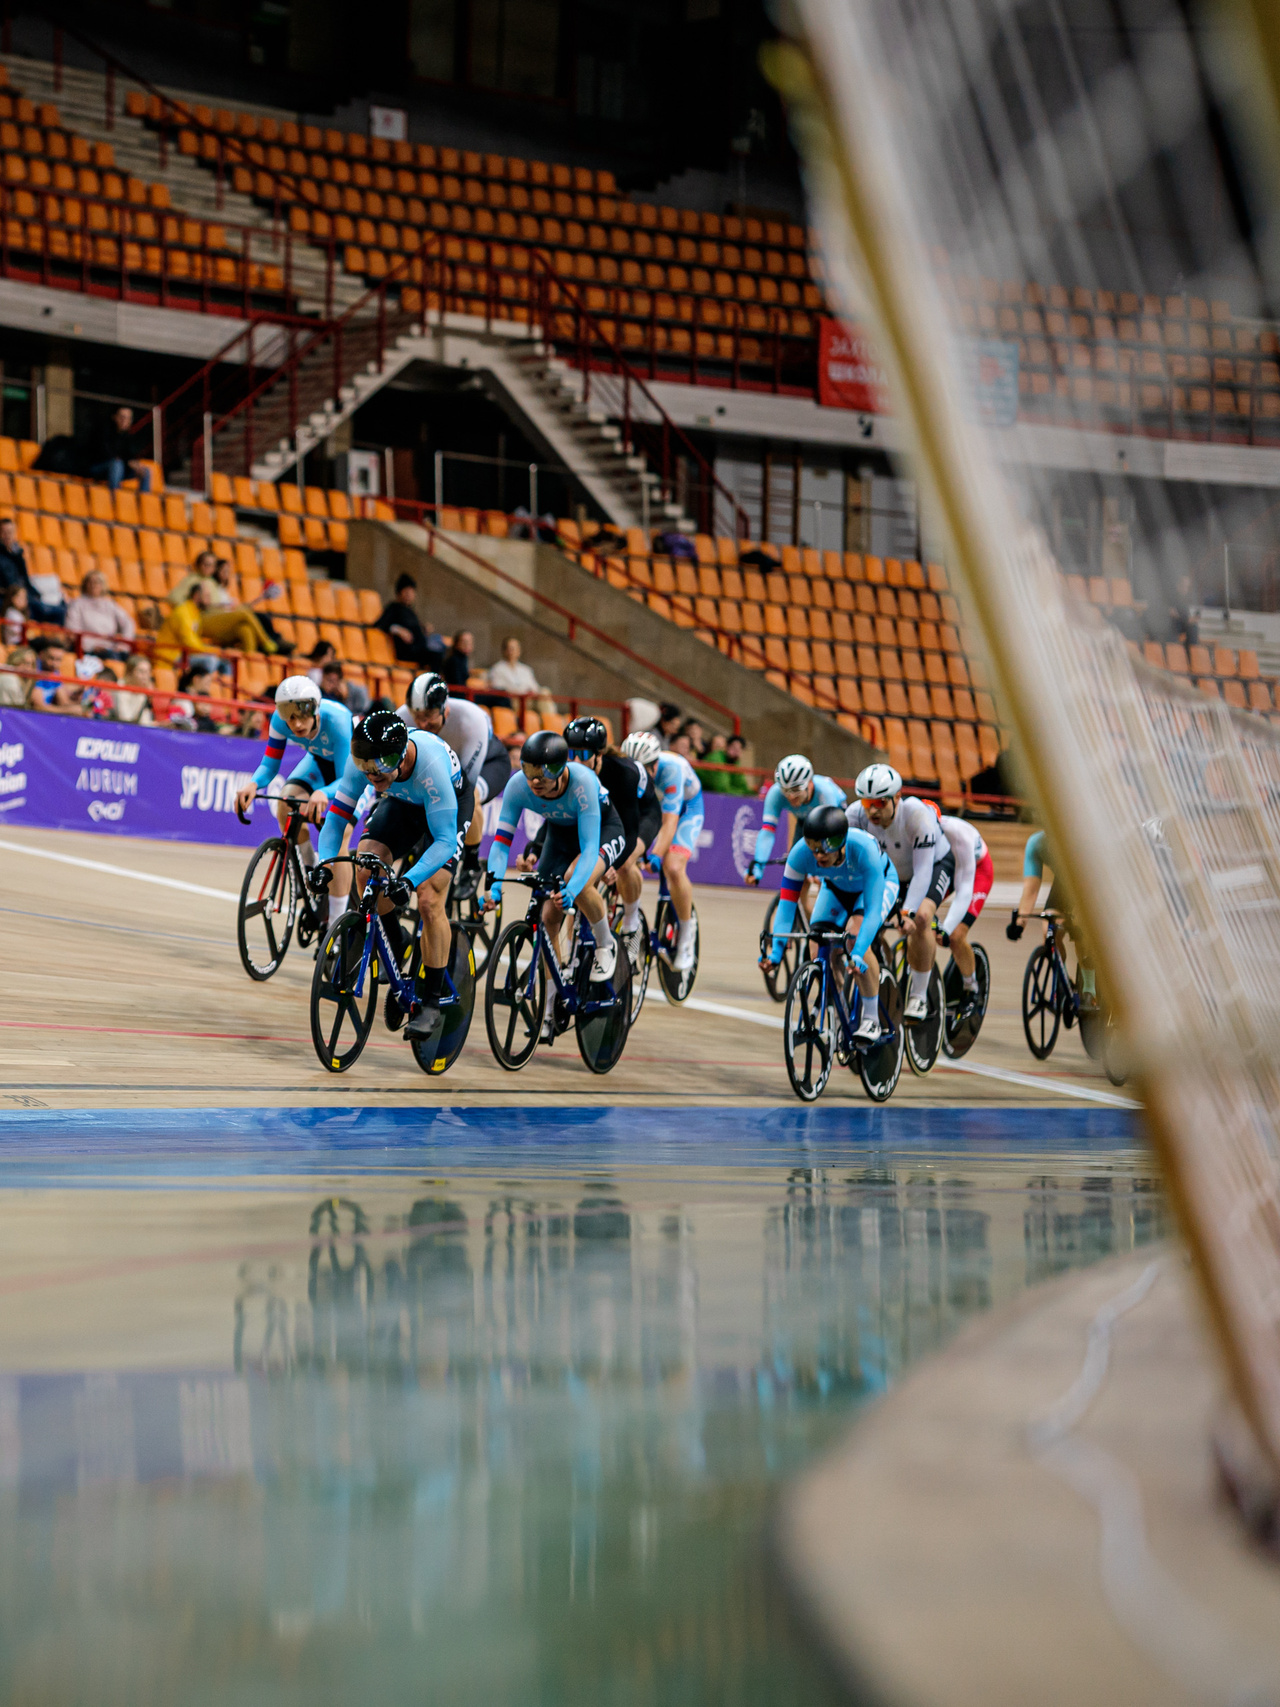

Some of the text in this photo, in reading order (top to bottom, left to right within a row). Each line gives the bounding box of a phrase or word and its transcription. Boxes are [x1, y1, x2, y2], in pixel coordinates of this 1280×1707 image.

[76, 768, 138, 796] AURUM
[180, 765, 255, 815] SPUTN
[421, 777, 440, 805] RCA
[573, 785, 589, 812] RCA
[601, 835, 626, 866] RCA
